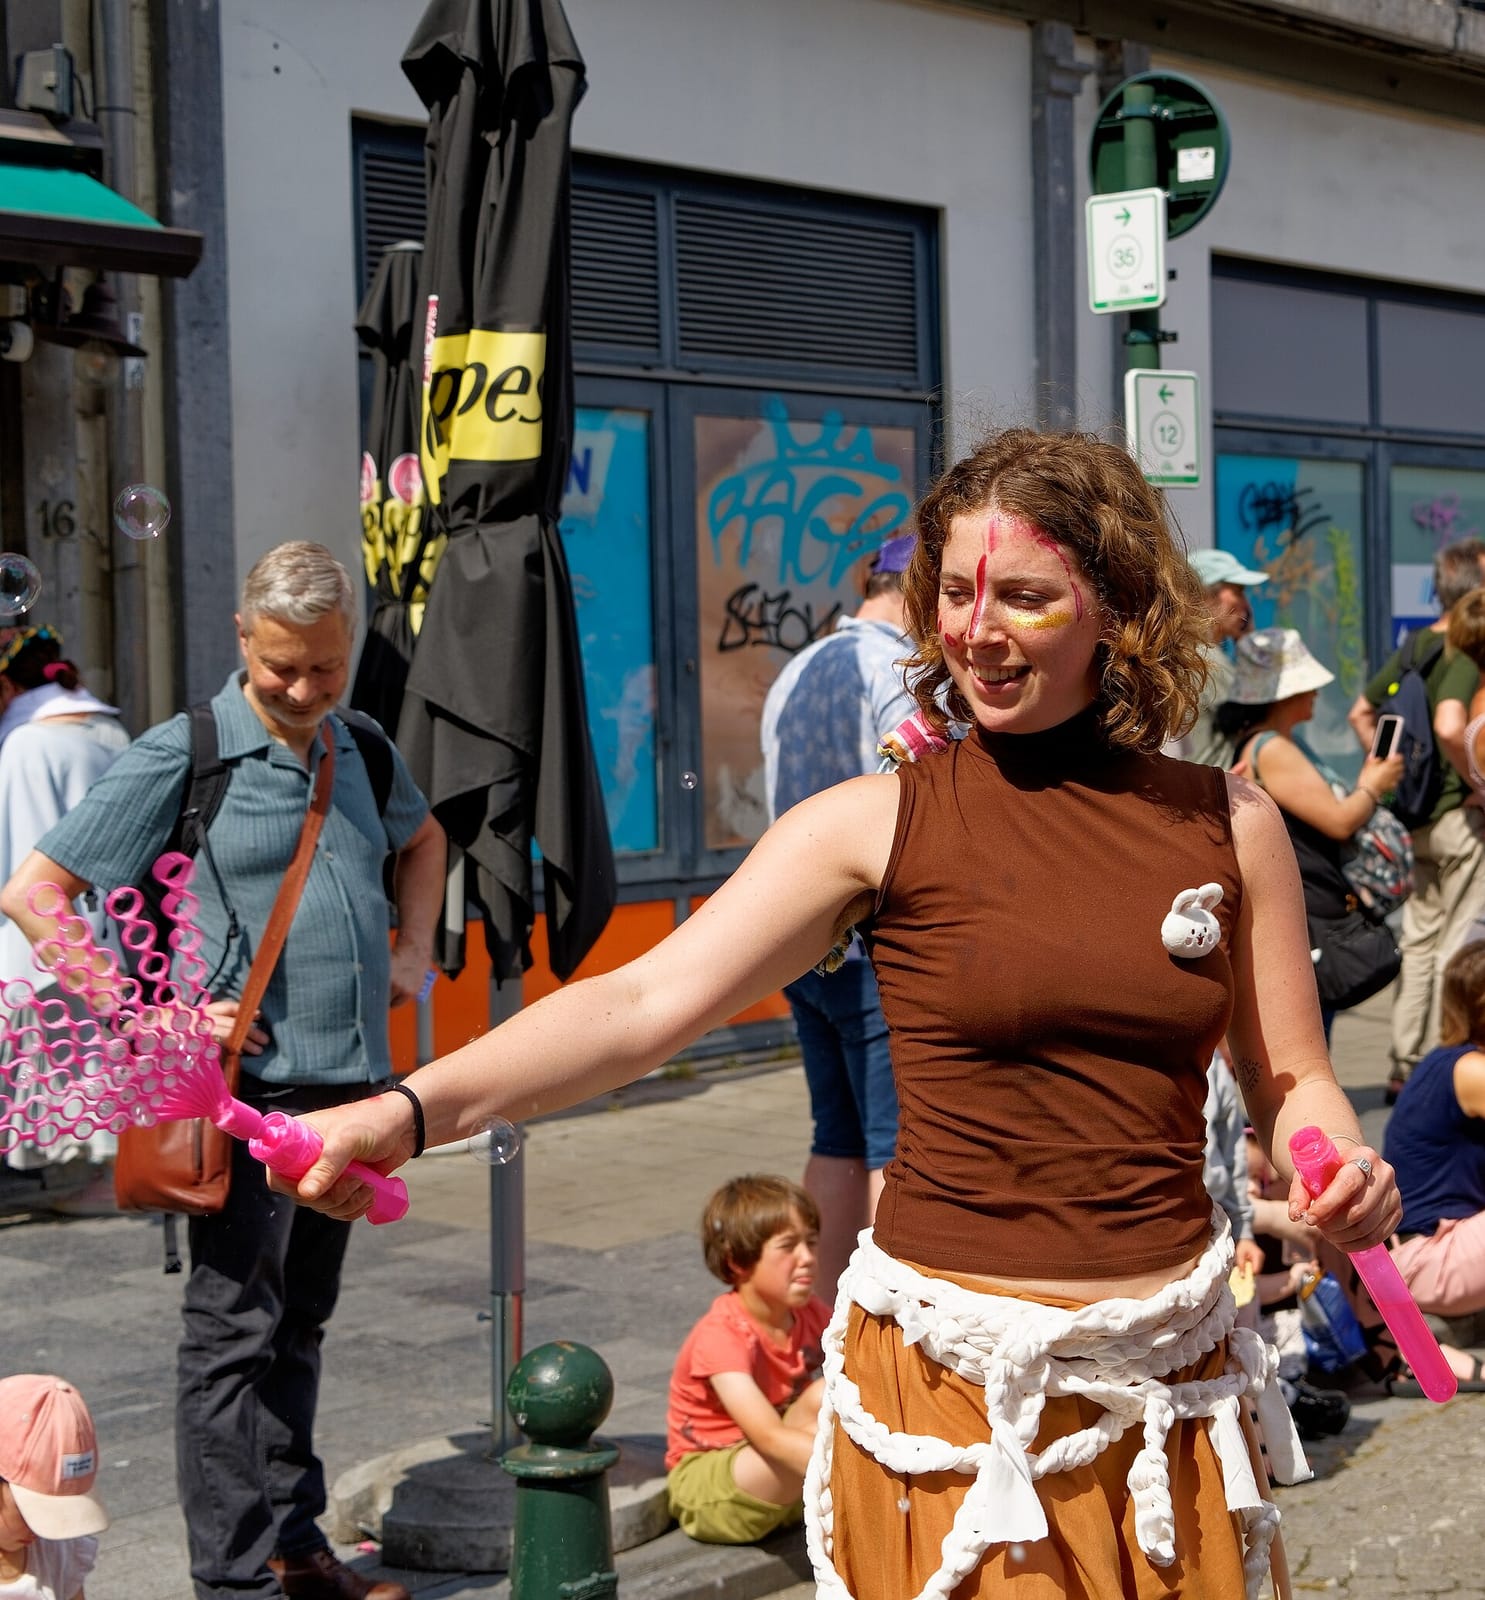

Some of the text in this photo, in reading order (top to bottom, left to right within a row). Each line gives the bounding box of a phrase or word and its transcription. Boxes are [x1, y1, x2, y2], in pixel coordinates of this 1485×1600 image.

[1113, 247, 1135, 269] 35
[1158, 425, 1178, 445] 12
[36, 500, 75, 539] 16
